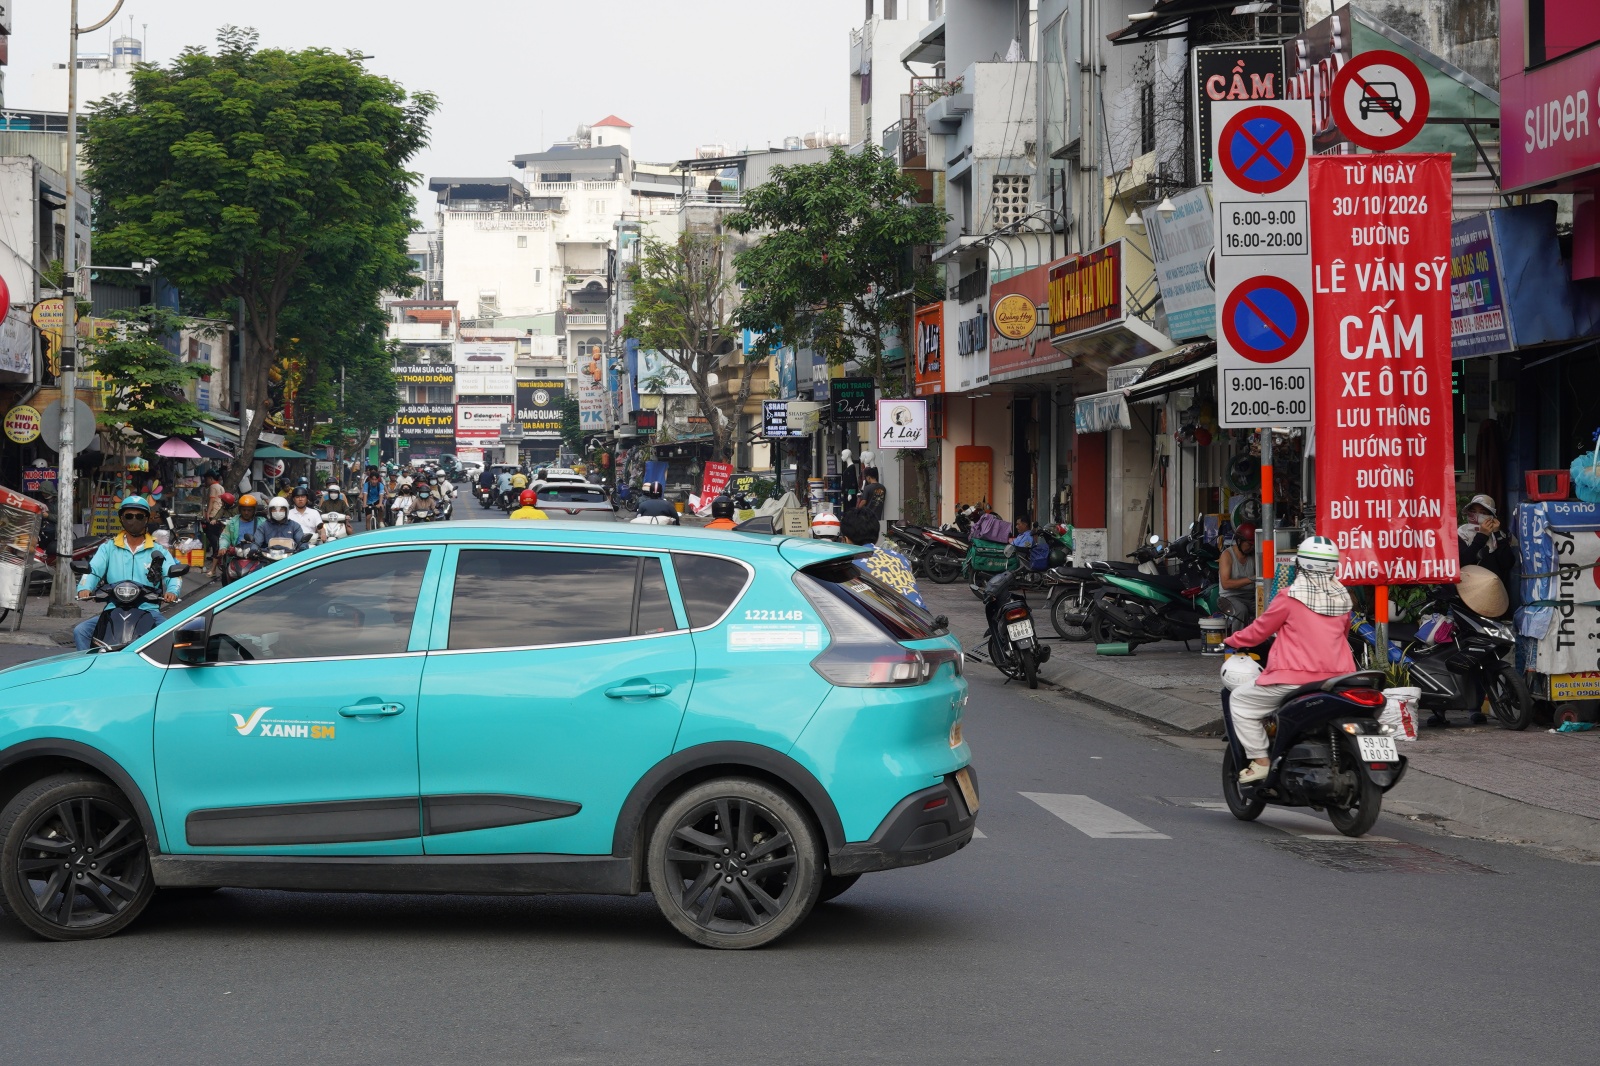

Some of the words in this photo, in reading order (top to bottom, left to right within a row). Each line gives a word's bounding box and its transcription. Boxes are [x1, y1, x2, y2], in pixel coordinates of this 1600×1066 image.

[1205, 59, 1275, 100] CẦM
[1343, 161, 1367, 185] TỪ
[1372, 159, 1417, 184] NGÀY
[1332, 195, 1428, 216] 30/10/2026
[1232, 210, 1296, 226] 6:00-9:00
[1226, 232, 1303, 248] 16:00-20:00
[1351, 221, 1410, 247] ĐƯỜNG
[1461, 253, 1475, 277] GAS
[1475, 250, 1489, 272] 406
[1315, 258, 1346, 294] LÊ
[1354, 256, 1405, 292] VĂN
[1414, 255, 1448, 291] SỸ
[1048, 271, 1063, 325] BÚN
[1082, 256, 1095, 314] HÀ
[1095, 247, 1114, 318] NỘI
[1339, 298, 1424, 361] CẤM
[408, 364, 422, 373] TÂM
[435, 364, 453, 373] CHỮA
[403, 375, 424, 385] THOẠI
[433, 374, 454, 384] ĐỘNG
[1232, 375, 1305, 391] 9:00-16:00
[1341, 371, 1370, 398] XE
[1379, 365, 1394, 397] Ô
[1399, 365, 1428, 396] TÔ
[518, 407, 538, 420] ĐĂNG
[1230, 400, 1307, 416] 20:00-6:00
[1336, 407, 1370, 428] LƯU
[1375, 404, 1431, 428] THÔNG
[15, 413, 33, 421] VINH
[417, 415, 437, 427] VIỆT
[438, 415, 452, 425] MỸ
[580, 410, 603, 423] 7K
[5, 420, 39, 431] KHÓA
[883, 426, 894, 439] A
[1342, 433, 1402, 458] HƯỚNG
[1406, 433, 1427, 457] TỪ
[43, 469, 56, 479] MÍA
[1356, 463, 1414, 489] ĐƯỜNG
[6, 492, 25, 508] 25
[1330, 496, 1359, 520] BÙI
[1364, 499, 1392, 522] THỊ
[1397, 495, 1441, 518] XUÂN
[1554, 502, 1570, 516] bộ
[1573, 502, 1596, 514] nhớ
[1337, 524, 1372, 550] ĐẾN
[1377, 524, 1436, 549] ĐƯỜNG
[1335, 556, 1378, 580] OÀNG
[1383, 556, 1417, 580] VĂN
[1421, 558, 1456, 582] THỤ
[744, 609, 803, 621] 122114B
[259, 723, 308, 738] XANH
[310, 725, 335, 739] SM
